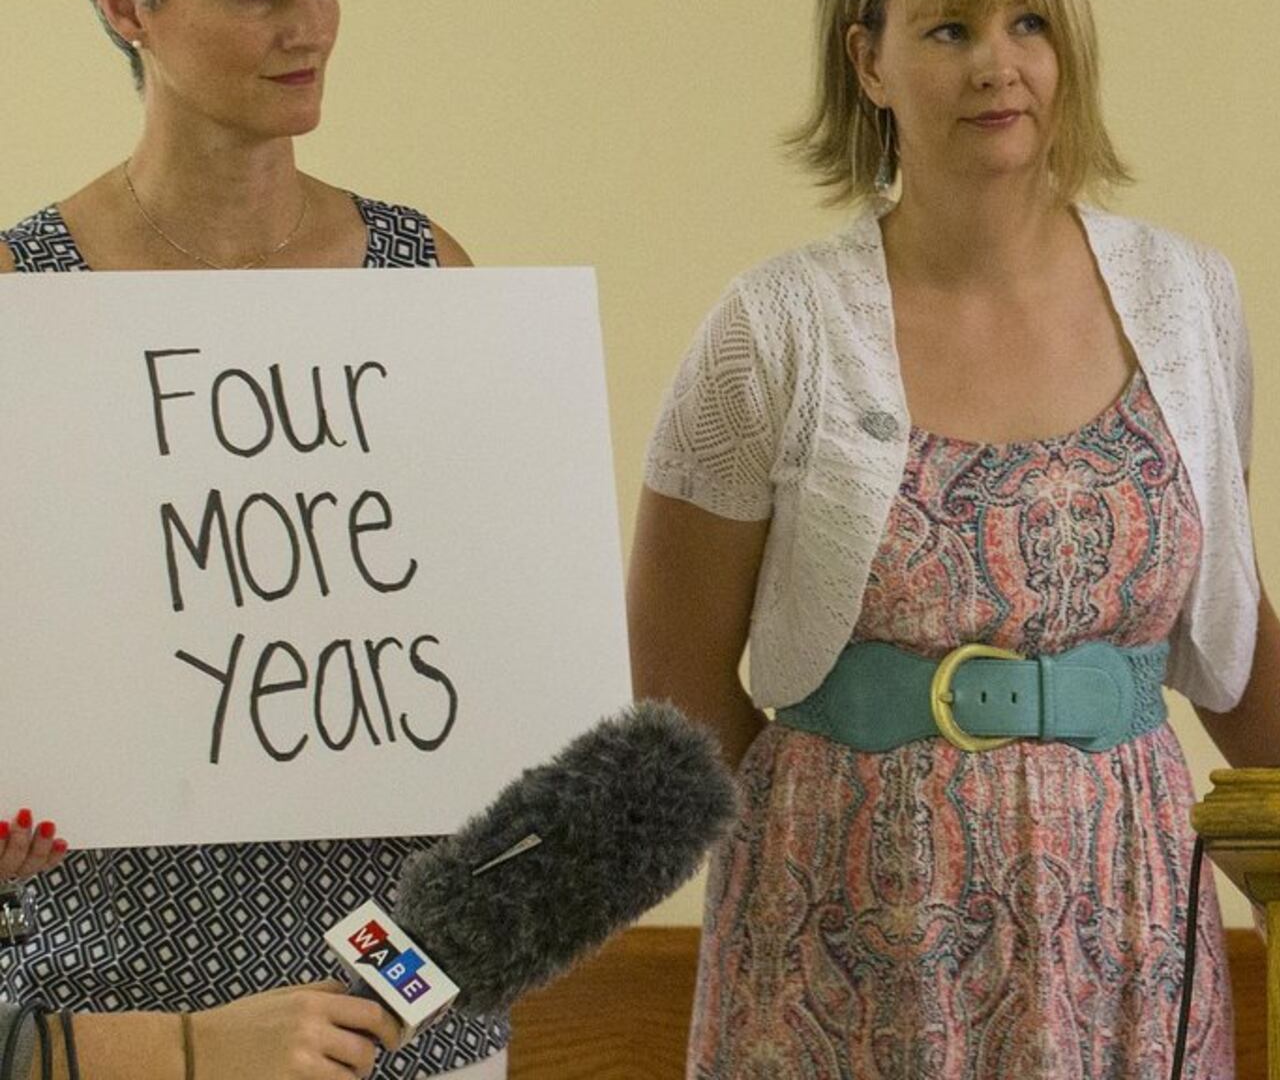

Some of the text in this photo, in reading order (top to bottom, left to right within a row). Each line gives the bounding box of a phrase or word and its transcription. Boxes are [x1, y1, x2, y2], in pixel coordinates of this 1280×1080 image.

[144, 348, 387, 458] Four
[160, 488, 418, 612] More
[175, 633, 459, 765] Years
[354, 927, 424, 999] WABE
